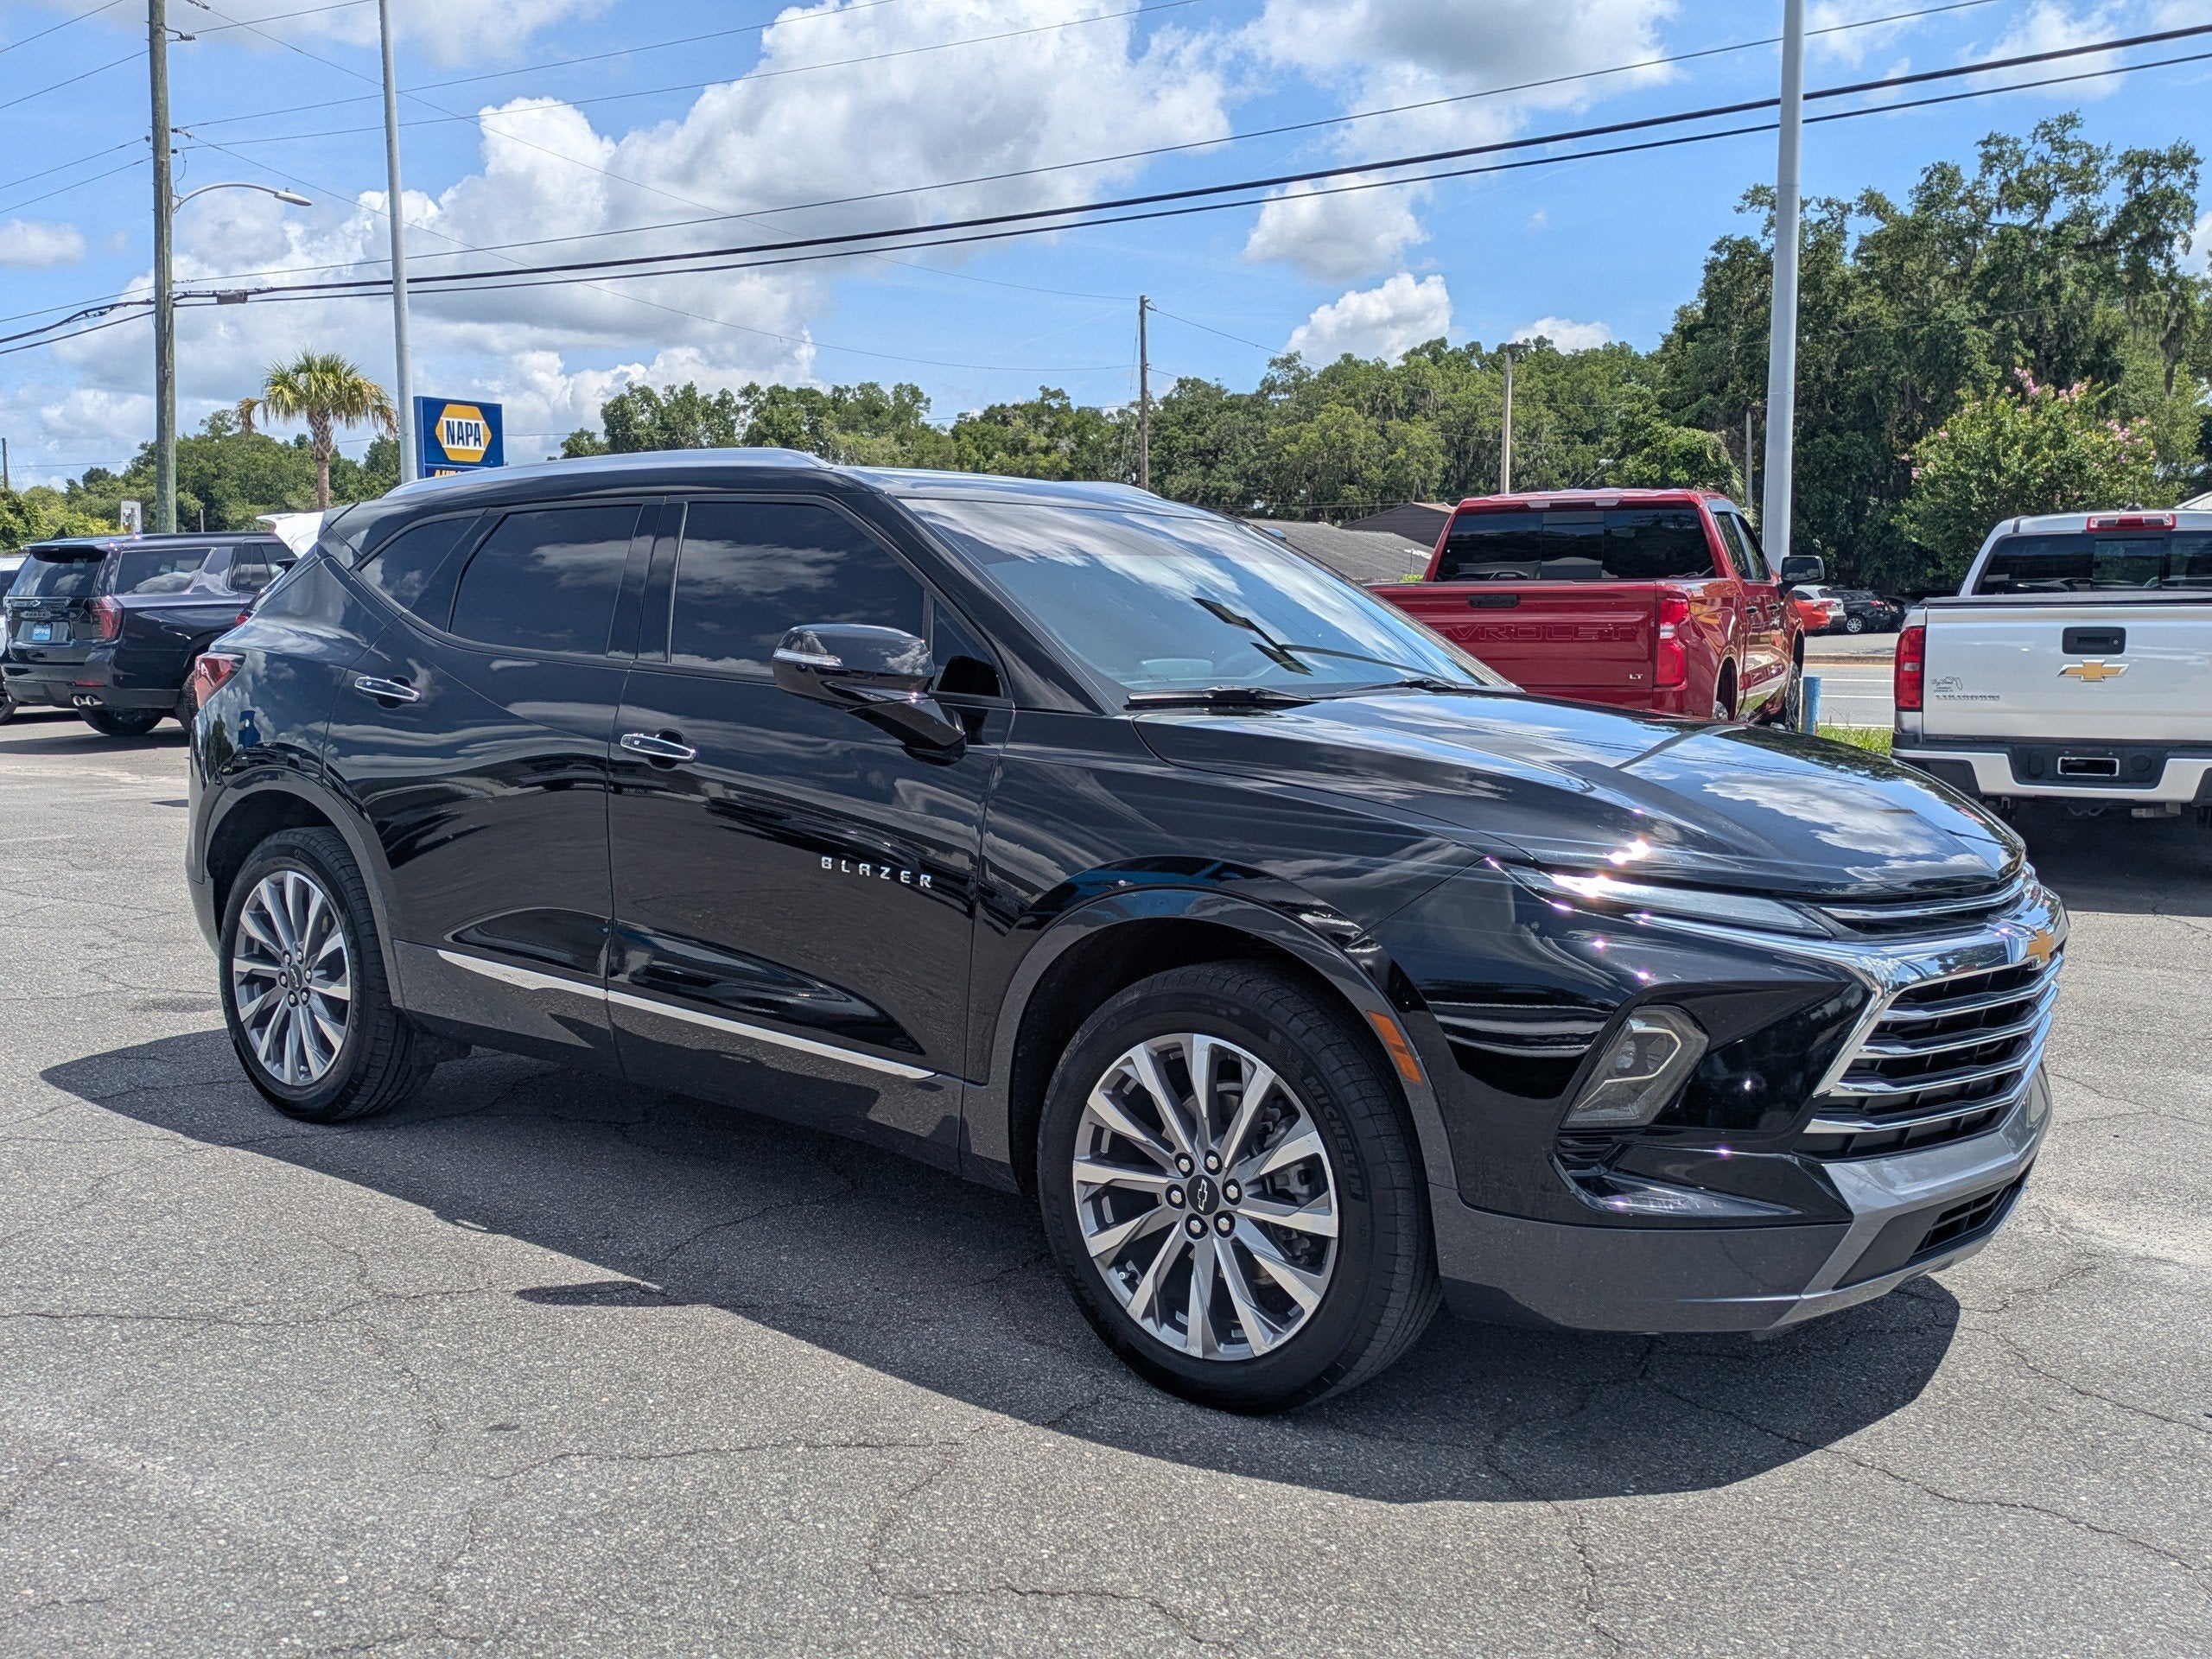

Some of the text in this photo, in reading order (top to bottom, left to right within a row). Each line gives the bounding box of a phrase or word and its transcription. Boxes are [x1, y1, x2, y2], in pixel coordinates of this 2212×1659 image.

[446, 420, 482, 448] NAPA
[1436, 624, 1631, 640] VROLET
[821, 856, 931, 888] BLAZER
[1304, 1076, 1370, 1203] MICHELIN
